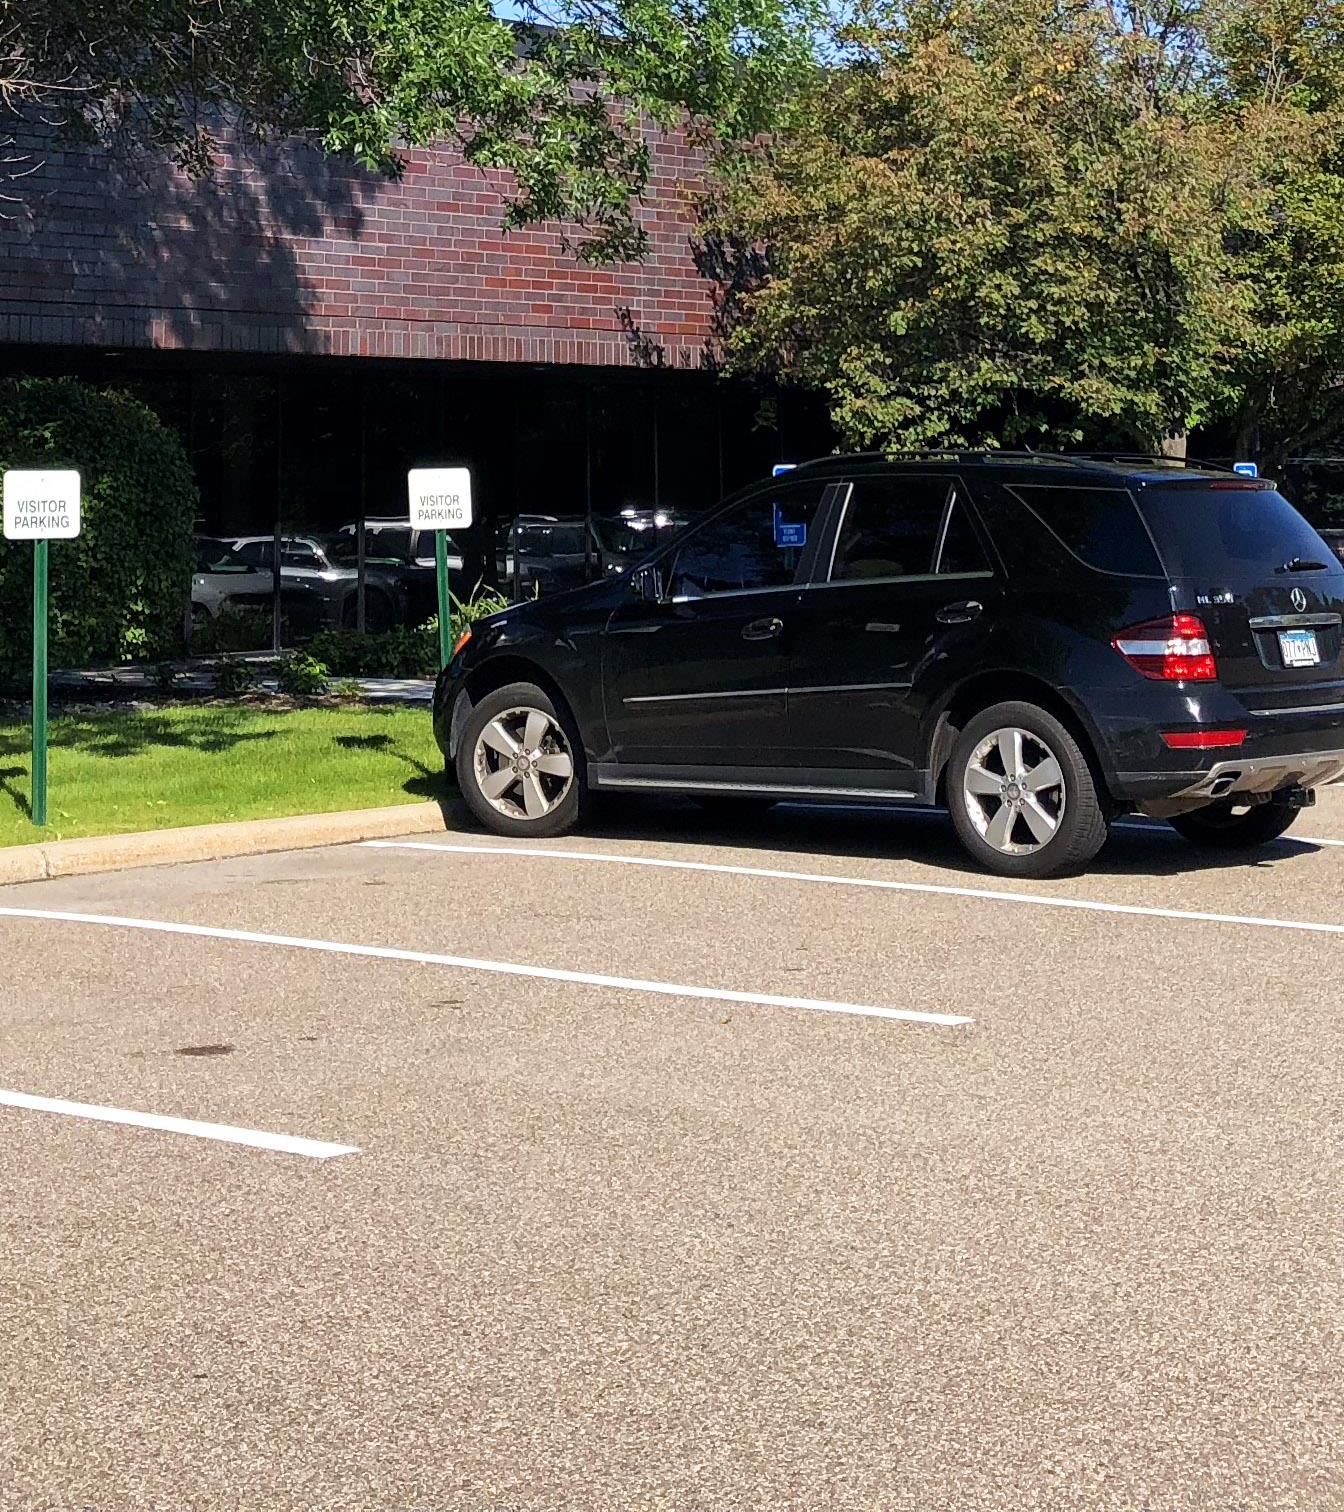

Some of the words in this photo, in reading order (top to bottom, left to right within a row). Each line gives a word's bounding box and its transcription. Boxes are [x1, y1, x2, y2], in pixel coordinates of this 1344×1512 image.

[419, 494, 460, 506] VISITOR
[17, 500, 67, 513] VISITOR
[418, 508, 463, 520] PARKING
[14, 515, 70, 529] PARKING
